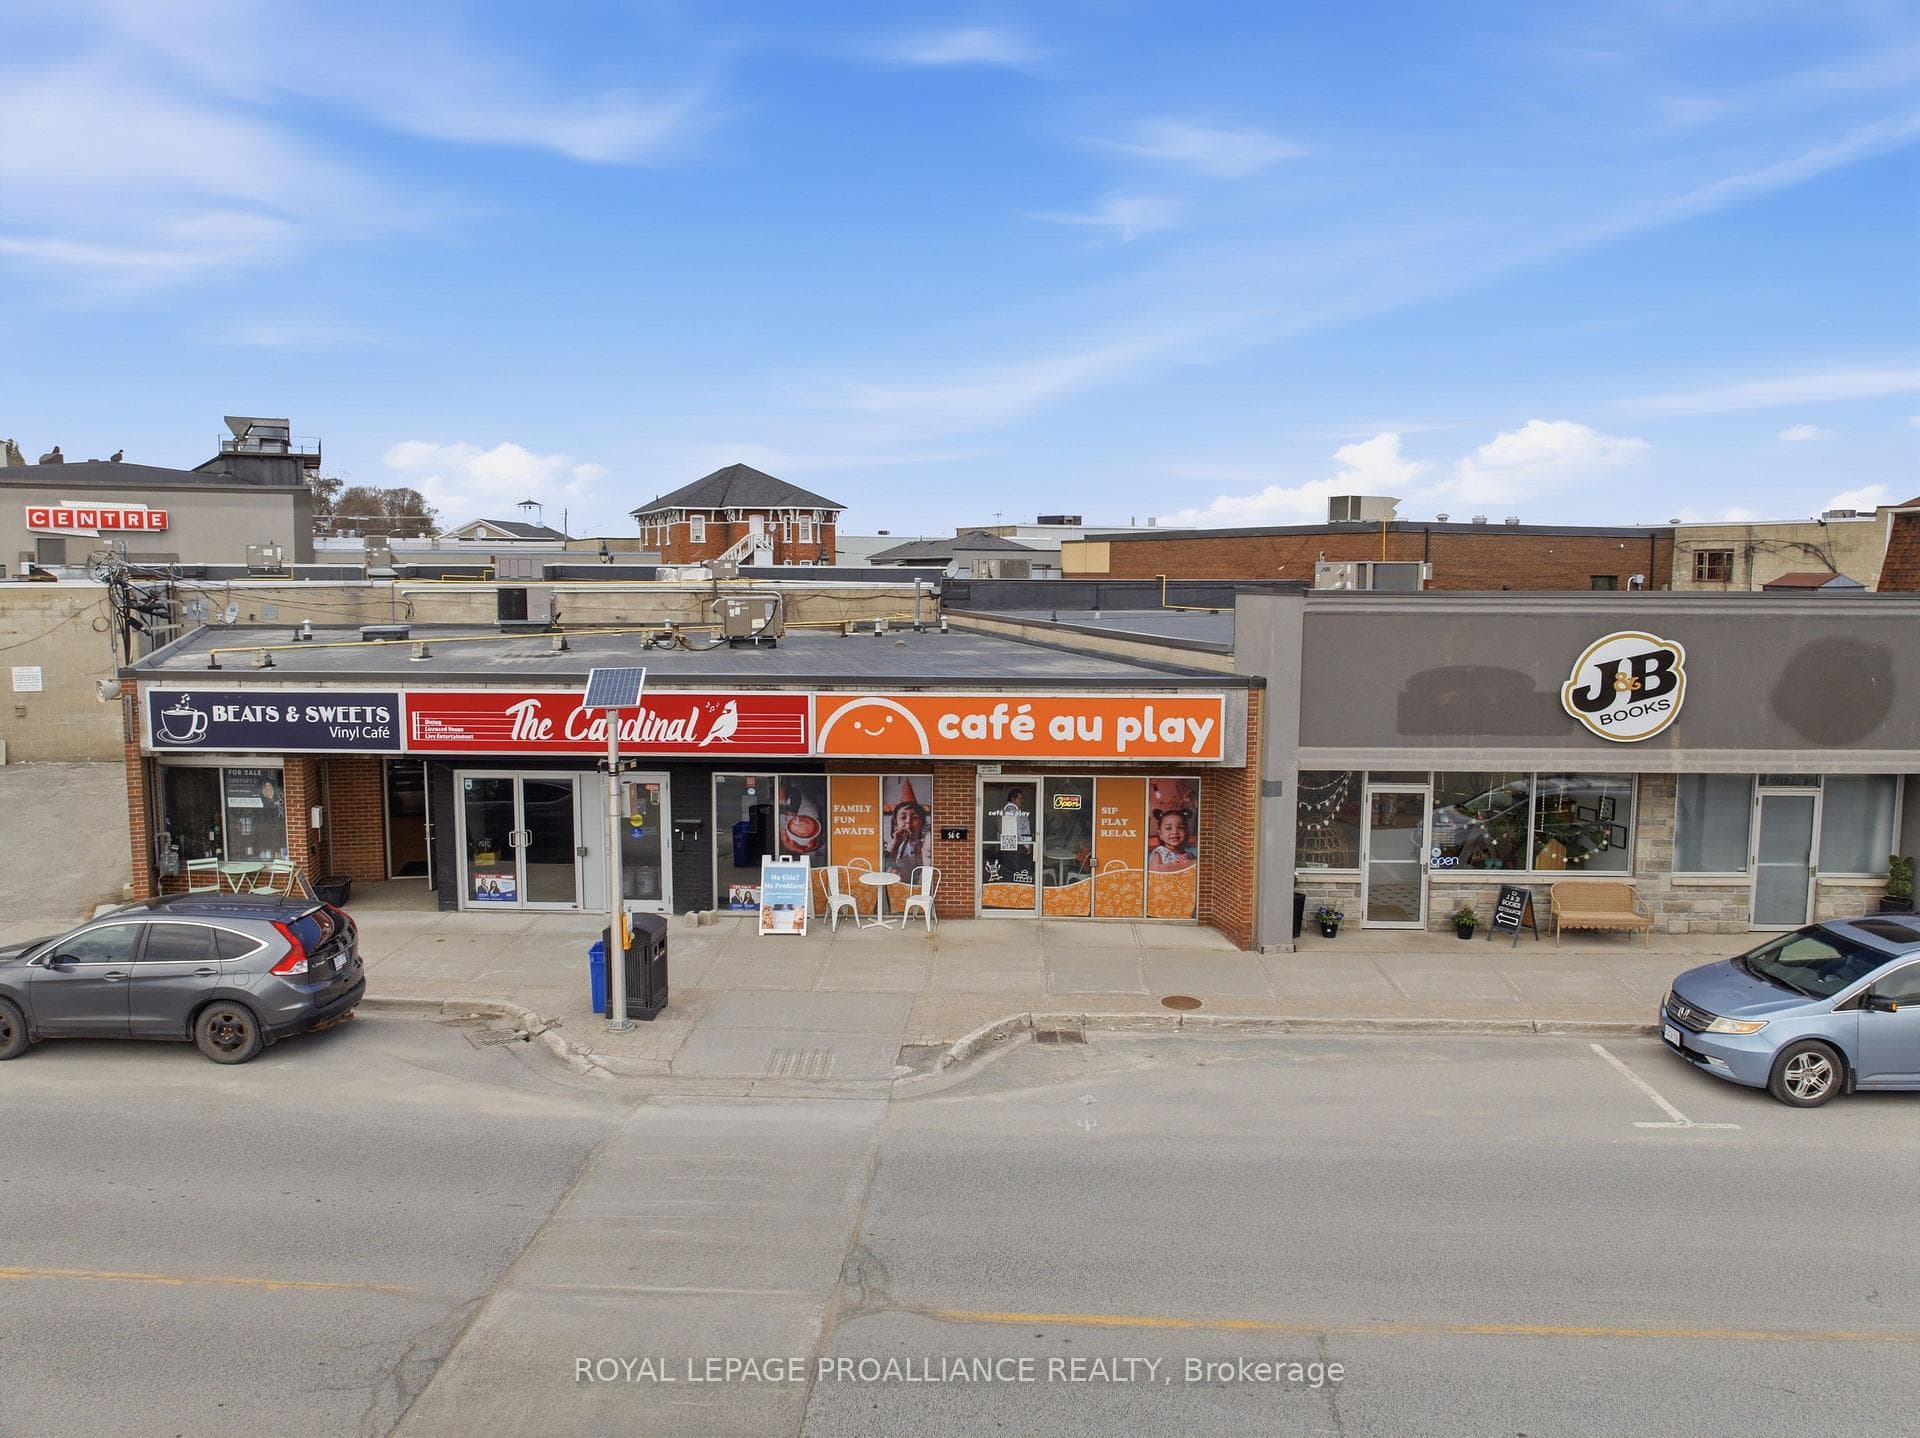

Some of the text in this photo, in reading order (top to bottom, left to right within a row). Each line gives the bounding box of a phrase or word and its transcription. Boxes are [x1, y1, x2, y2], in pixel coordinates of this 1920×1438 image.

[32, 511, 162, 526] CENTRE
[212, 705, 390, 723] BEATS & SWEETS
[505, 698, 553, 741] The
[1600, 699, 1671, 725] BOOKS
[329, 726, 390, 741] Vinyl Café
[937, 703, 1215, 753] café au play
[834, 804, 872, 813] FAMILY
[1101, 807, 1118, 815] SIP
[834, 827, 875, 835] AWAITS
[1431, 856, 1459, 868] open
